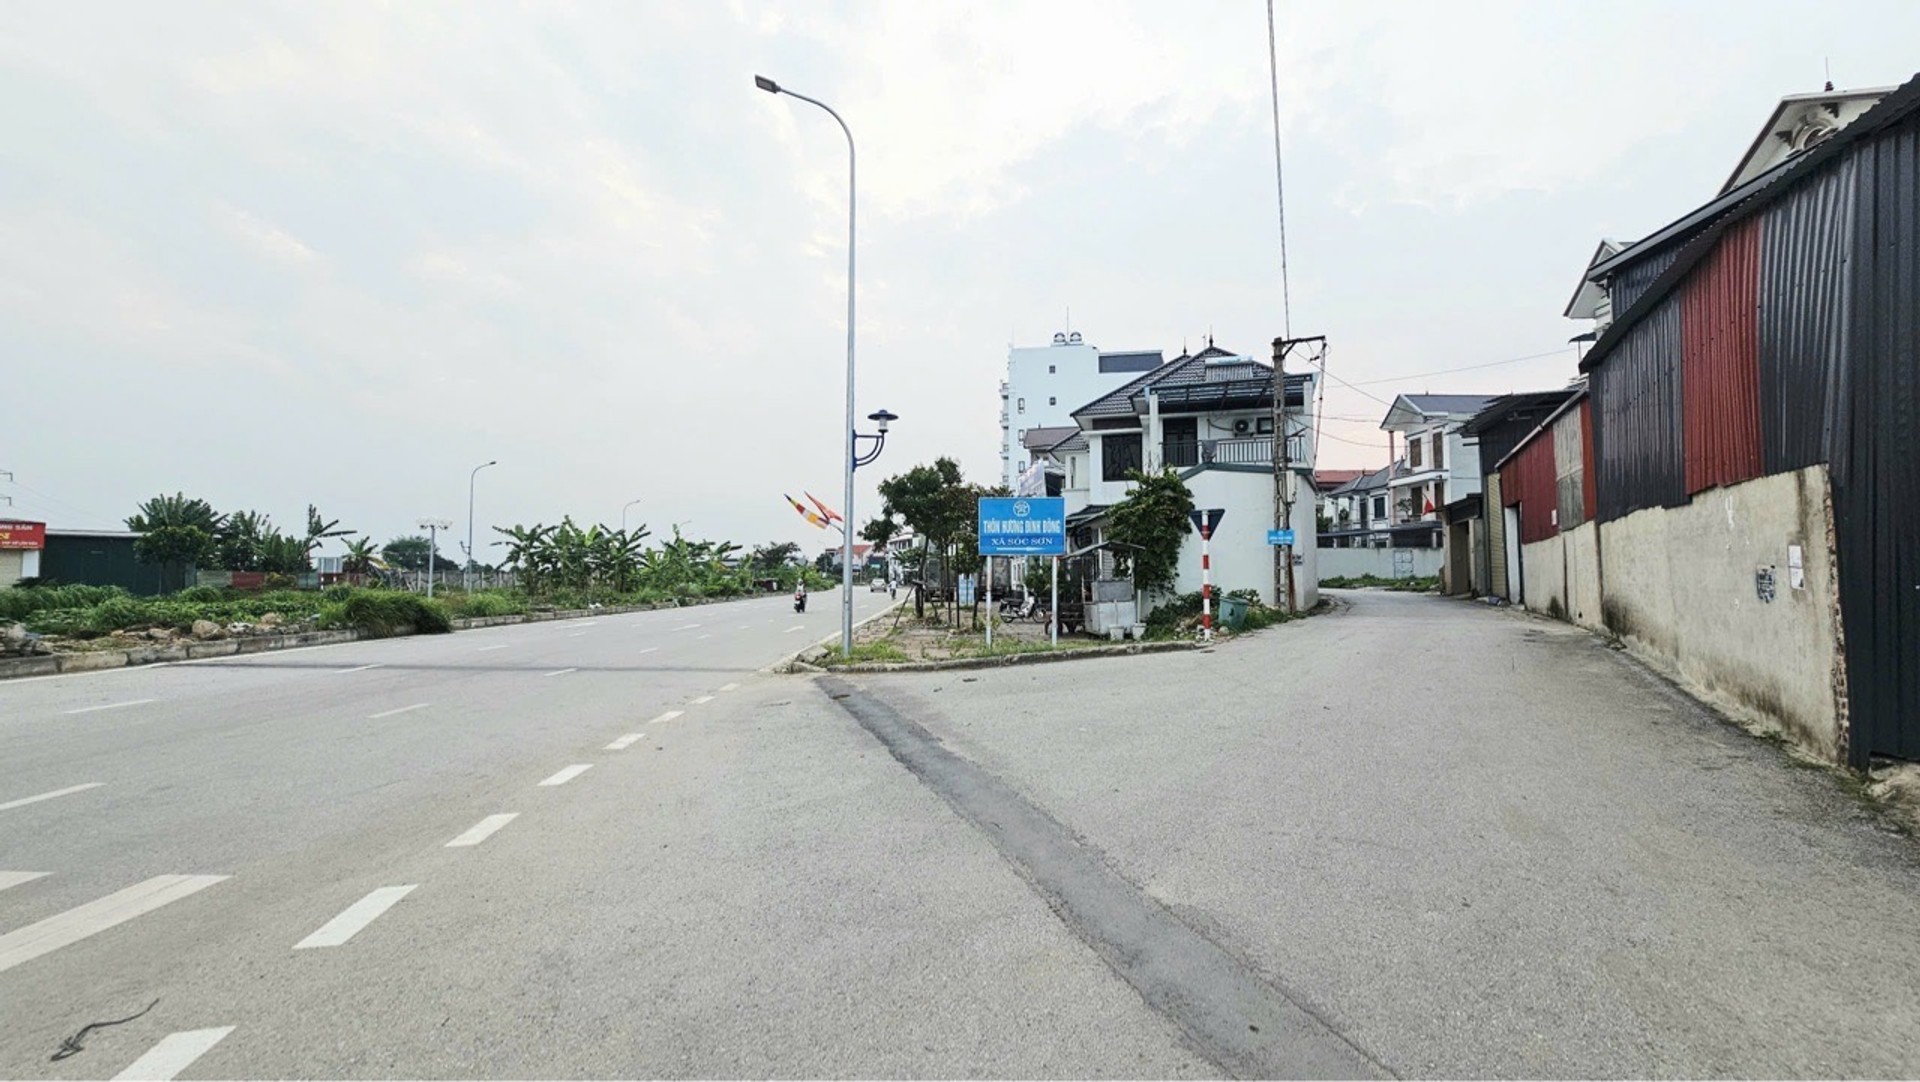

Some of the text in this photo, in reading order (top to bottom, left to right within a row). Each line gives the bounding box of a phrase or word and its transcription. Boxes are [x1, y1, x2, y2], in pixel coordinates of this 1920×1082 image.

[983, 517, 1000, 534] THÔN
[991, 537, 1053, 546] XÃ SÓC SƠN
